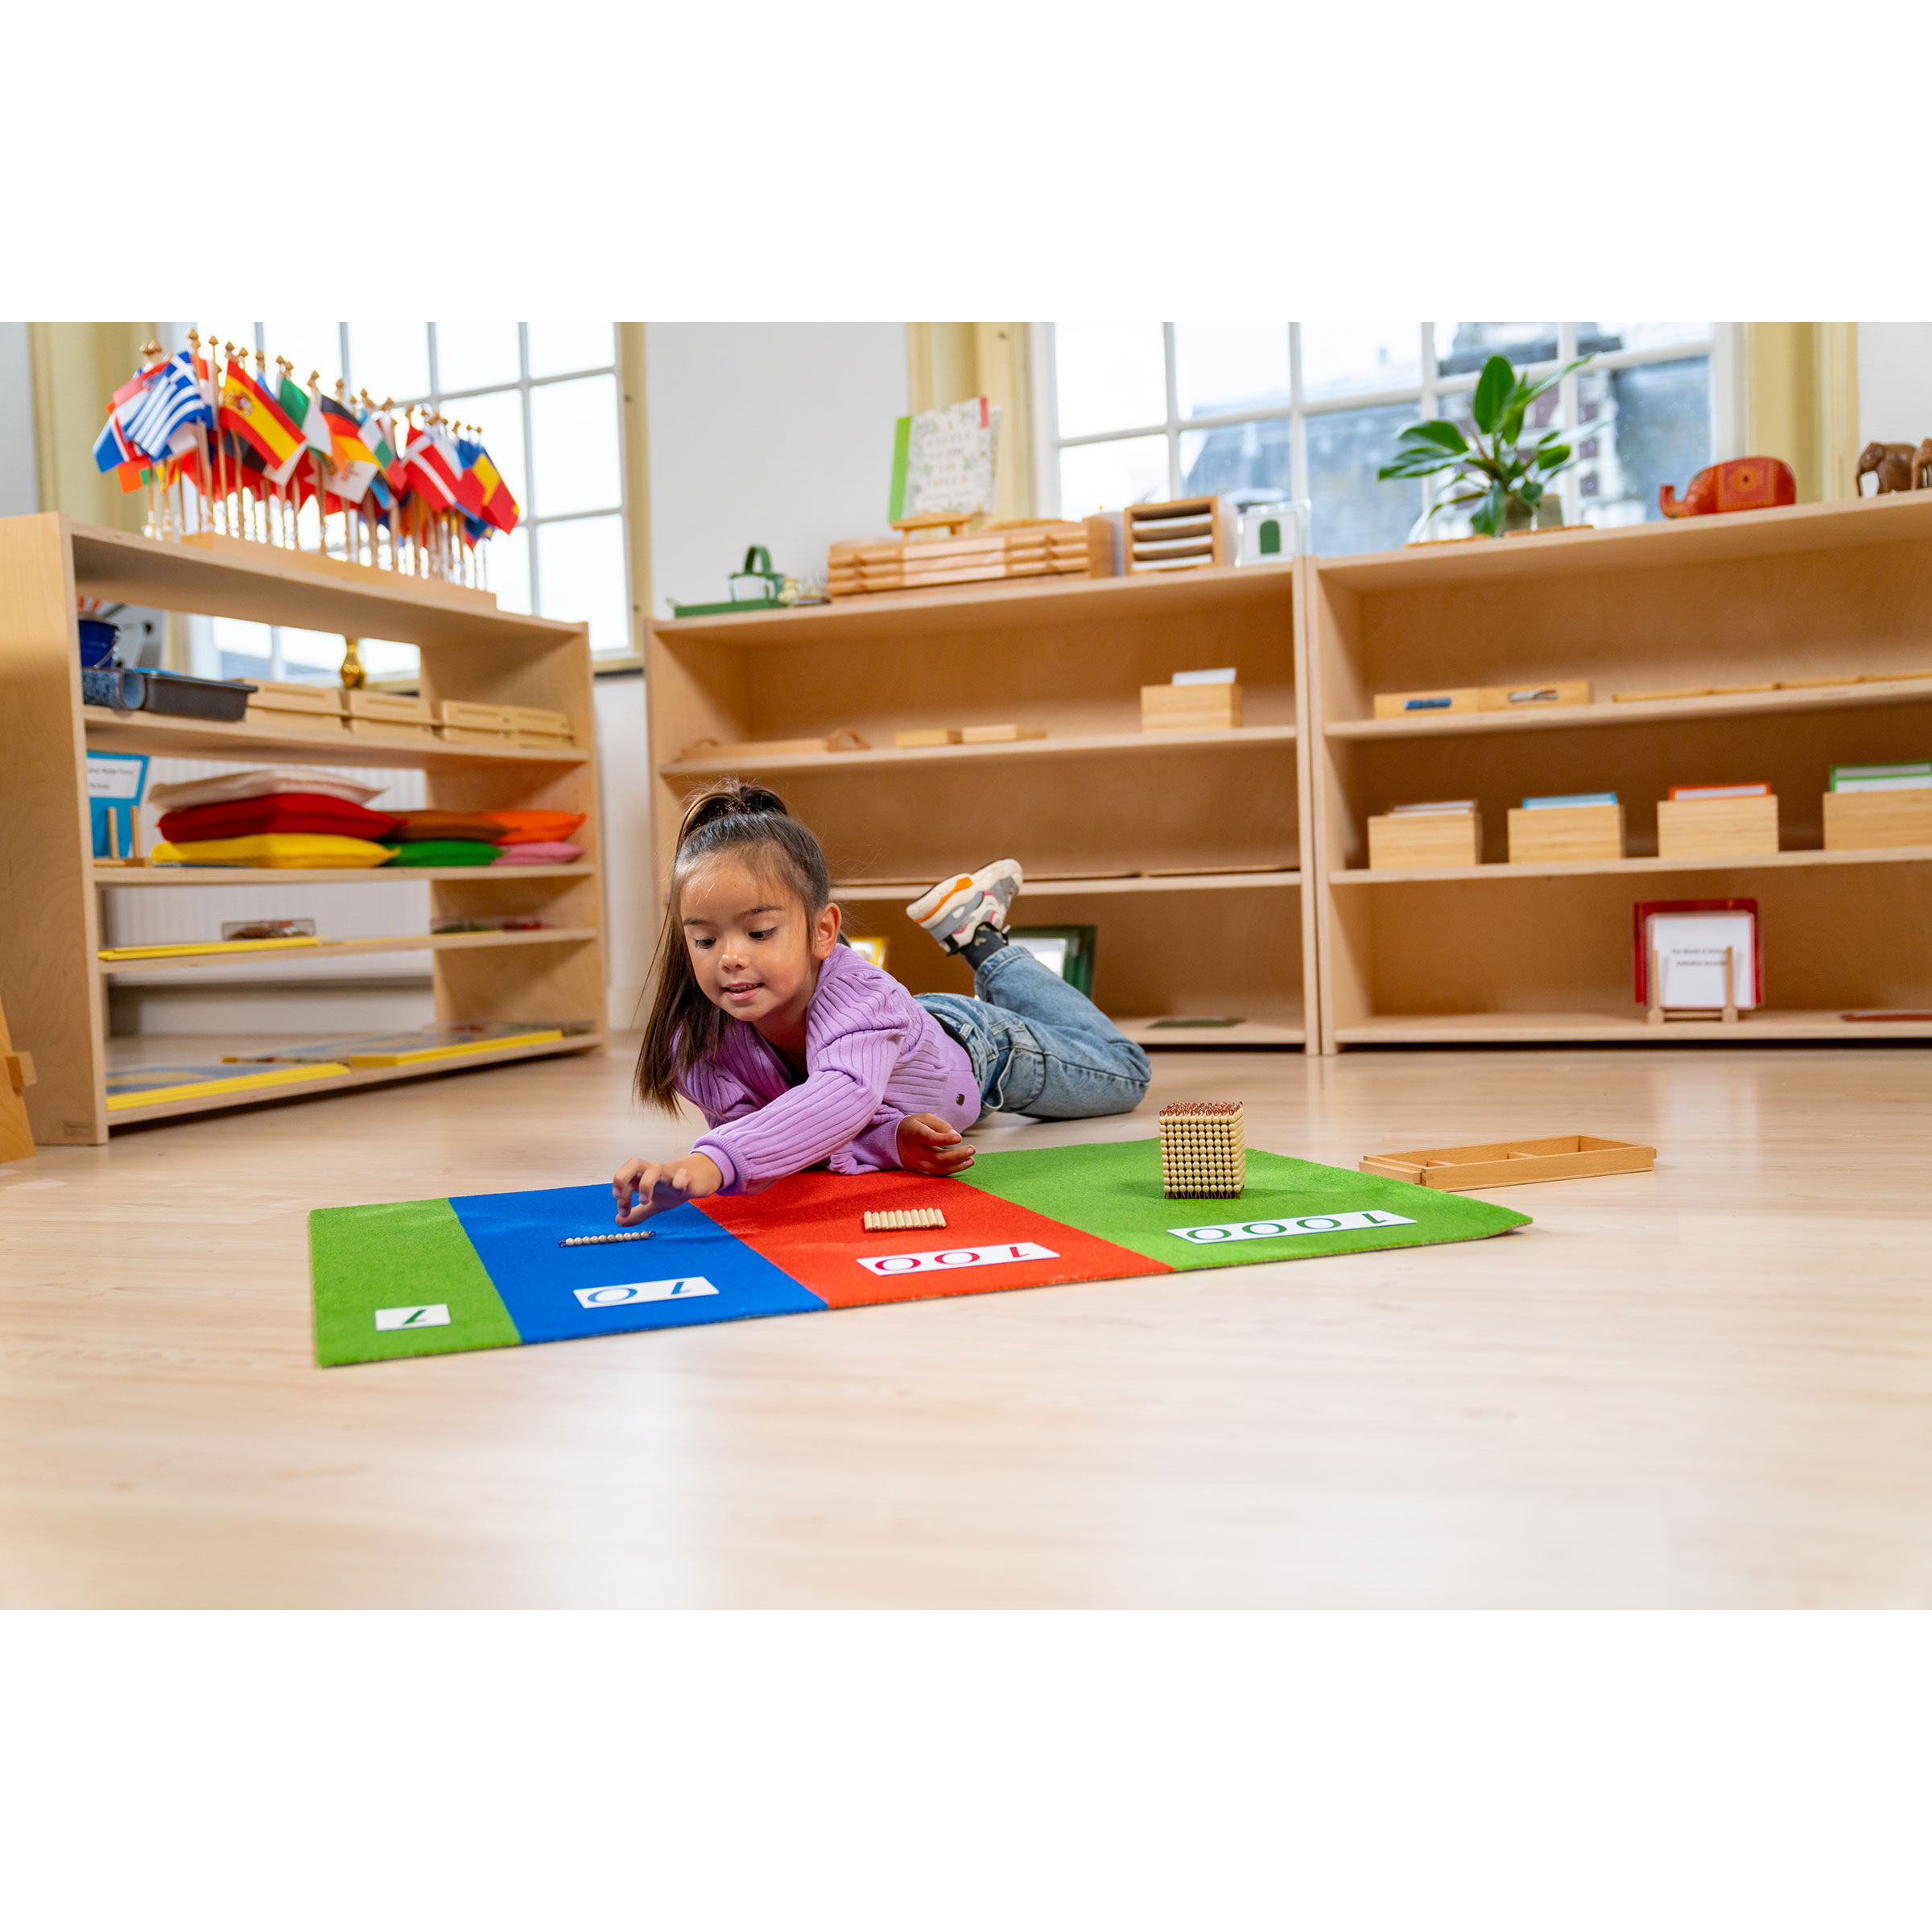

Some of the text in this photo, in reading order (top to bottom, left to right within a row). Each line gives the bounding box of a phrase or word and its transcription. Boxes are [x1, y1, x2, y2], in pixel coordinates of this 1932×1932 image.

[1186, 1212, 1387, 1241] 1000
[874, 1245, 1031, 1272] 100
[587, 1280, 691, 1304] 10
[402, 1309, 427, 1325] 1
